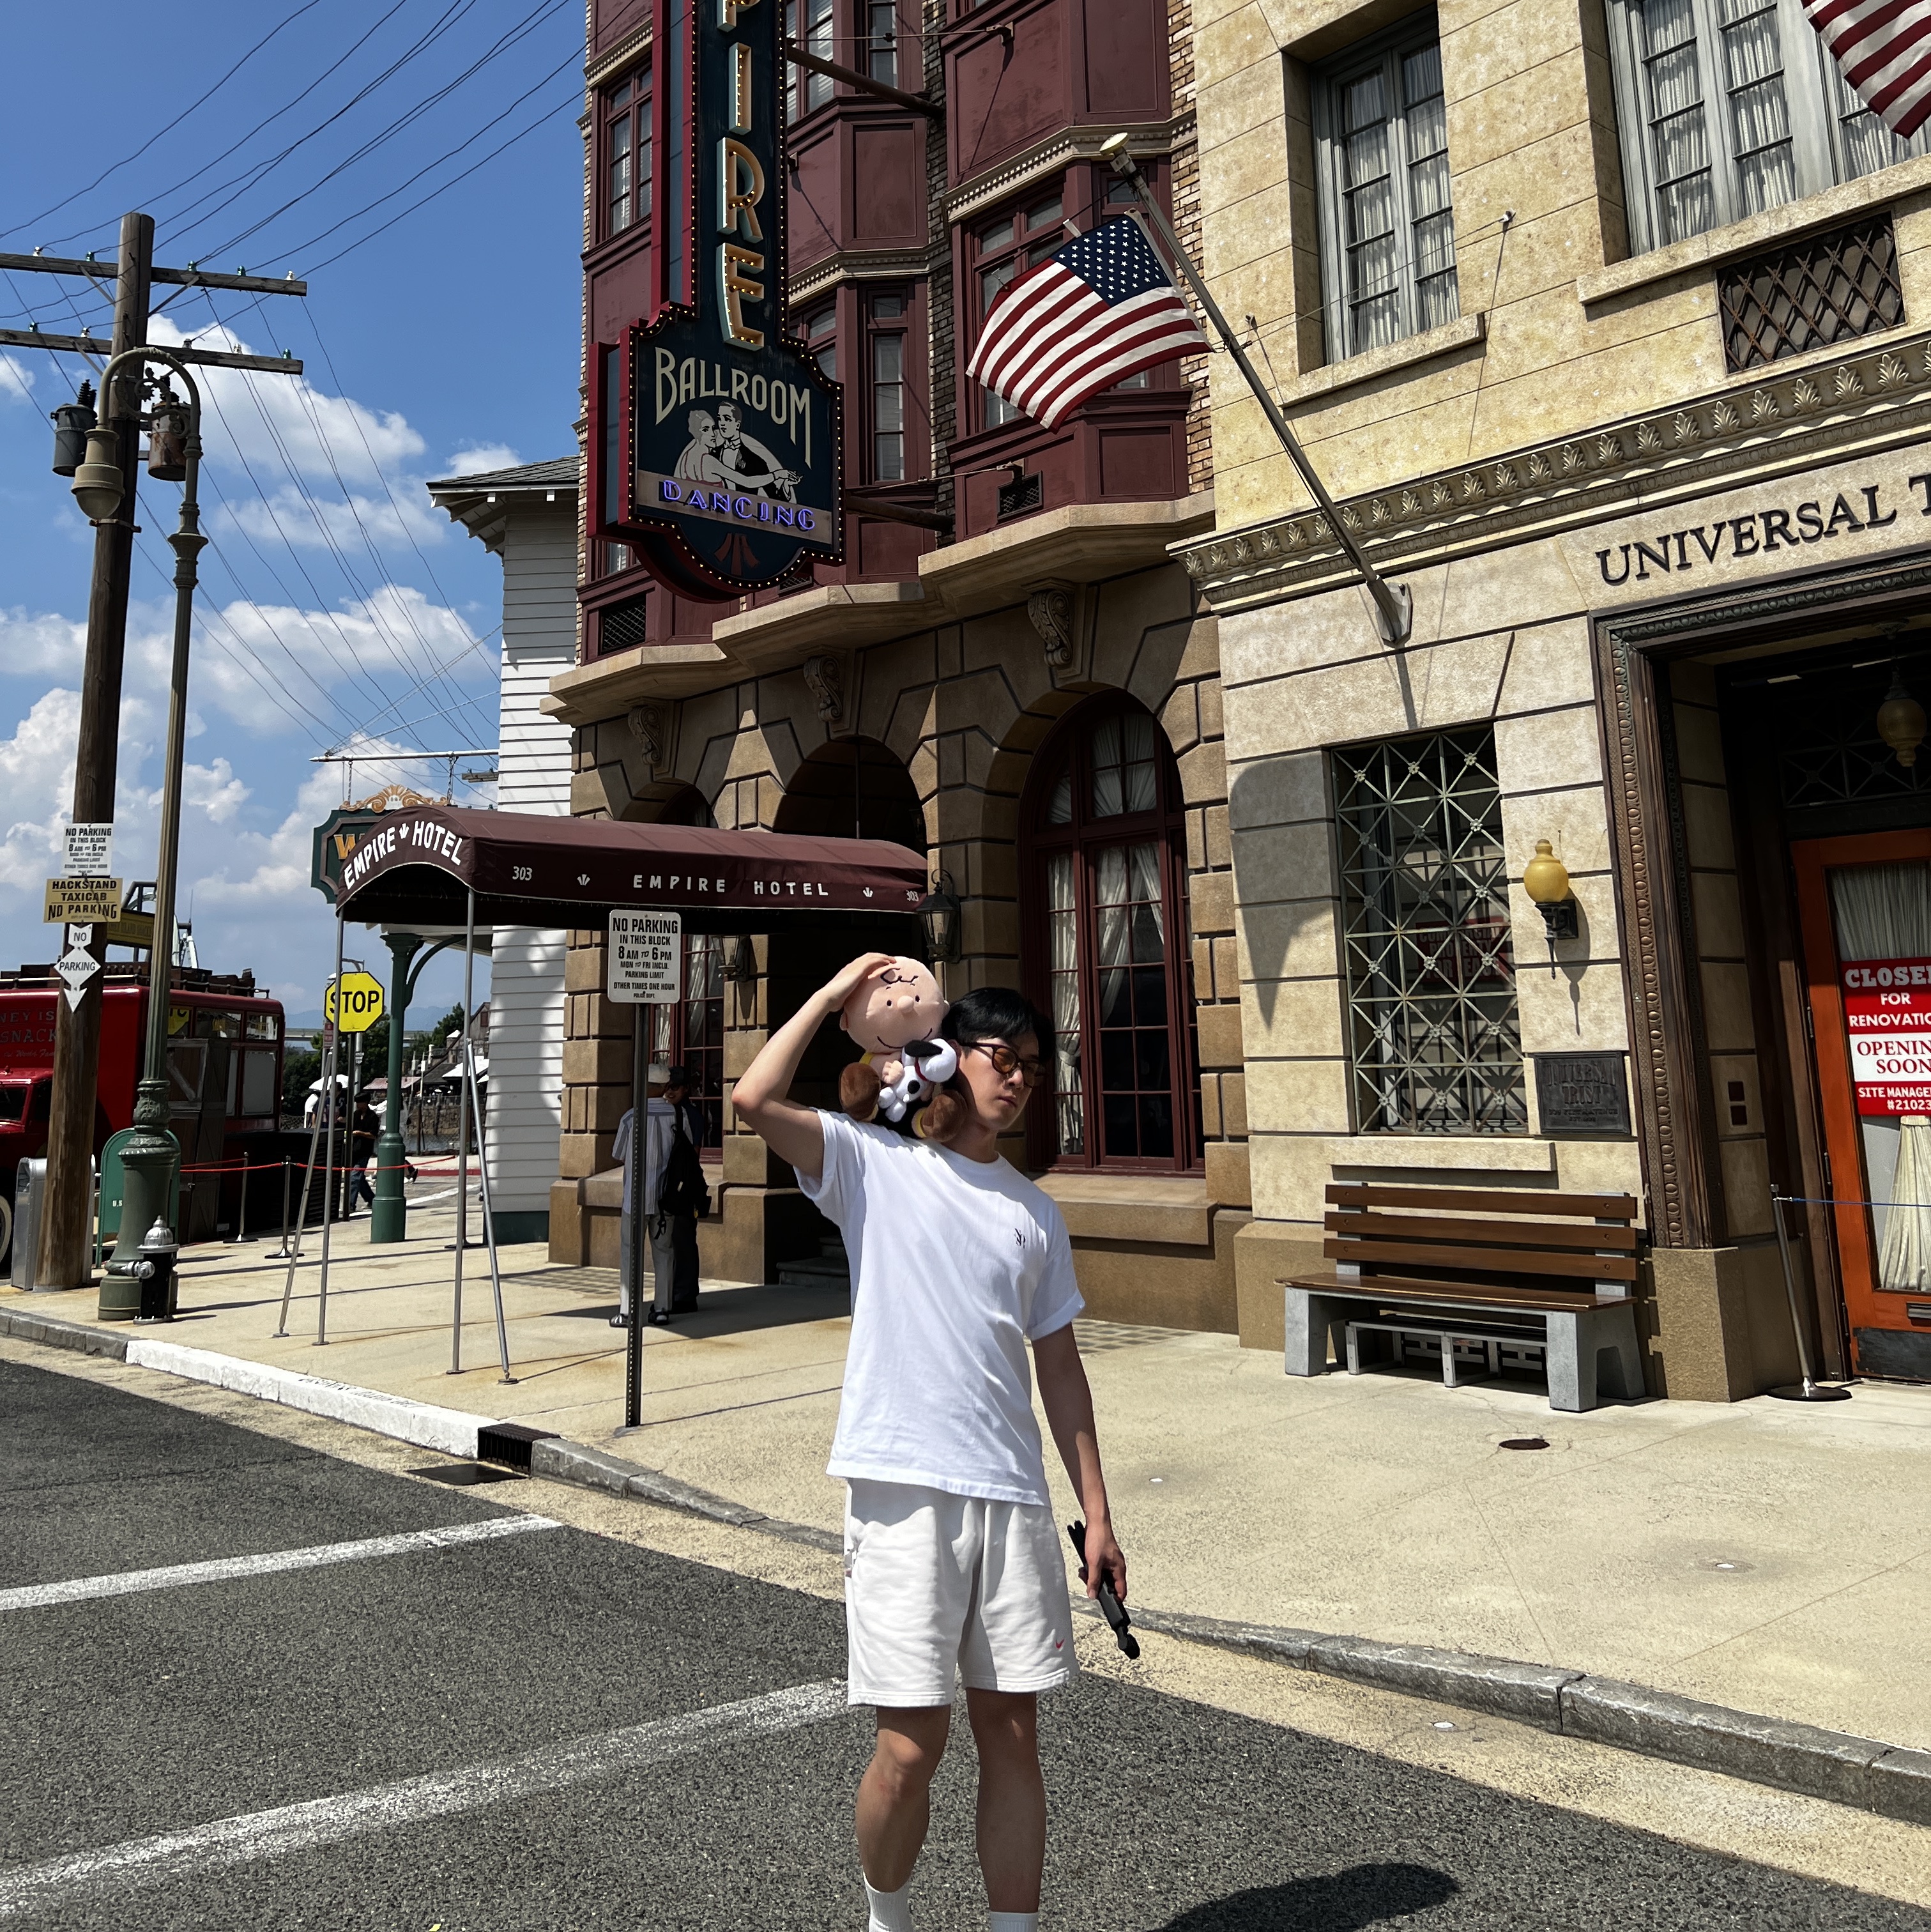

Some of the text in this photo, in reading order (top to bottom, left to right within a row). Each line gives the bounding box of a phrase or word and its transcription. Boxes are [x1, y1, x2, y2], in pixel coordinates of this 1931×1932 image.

[655, 346, 812, 470] BALLROOM
[662, 479, 816, 531] DANCING
[1595, 485, 1897, 586] UNIVERSAL
[65, 827, 112, 836] NO PARKING
[68, 843, 73, 852] 8
[344, 820, 463, 890] EMPIRE HOTEL
[512, 866, 533, 881] 303
[52, 880, 117, 889] HACKSTAND
[633, 874, 828, 896] EMPIRE HOTEL
[61, 893, 107, 901] TAXICAB
[905, 889, 920, 902] 303
[48, 904, 118, 921] NO PARKING
[613, 917, 678, 933] NO PARKING
[73, 932, 87, 942] NO
[620, 934, 671, 946] IN THIS BLOCK
[1419, 927, 1501, 943] COMRCIAL
[618, 946, 625, 959] 8
[626, 950, 639, 959] AM
[652, 947, 659, 960] 6
[660, 951, 671, 960] PM
[1429, 939, 1493, 958] PROERTY
[59, 962, 96, 971] PARKING
[1880, 992, 1912, 1006] FOR
[1856, 1039, 1931, 1056] OPENIN
[1876, 1058, 1931, 1074] SOON
[1858, 1087, 1886, 1098] SITE
[1887, 1099, 1931, 1110] #21023
